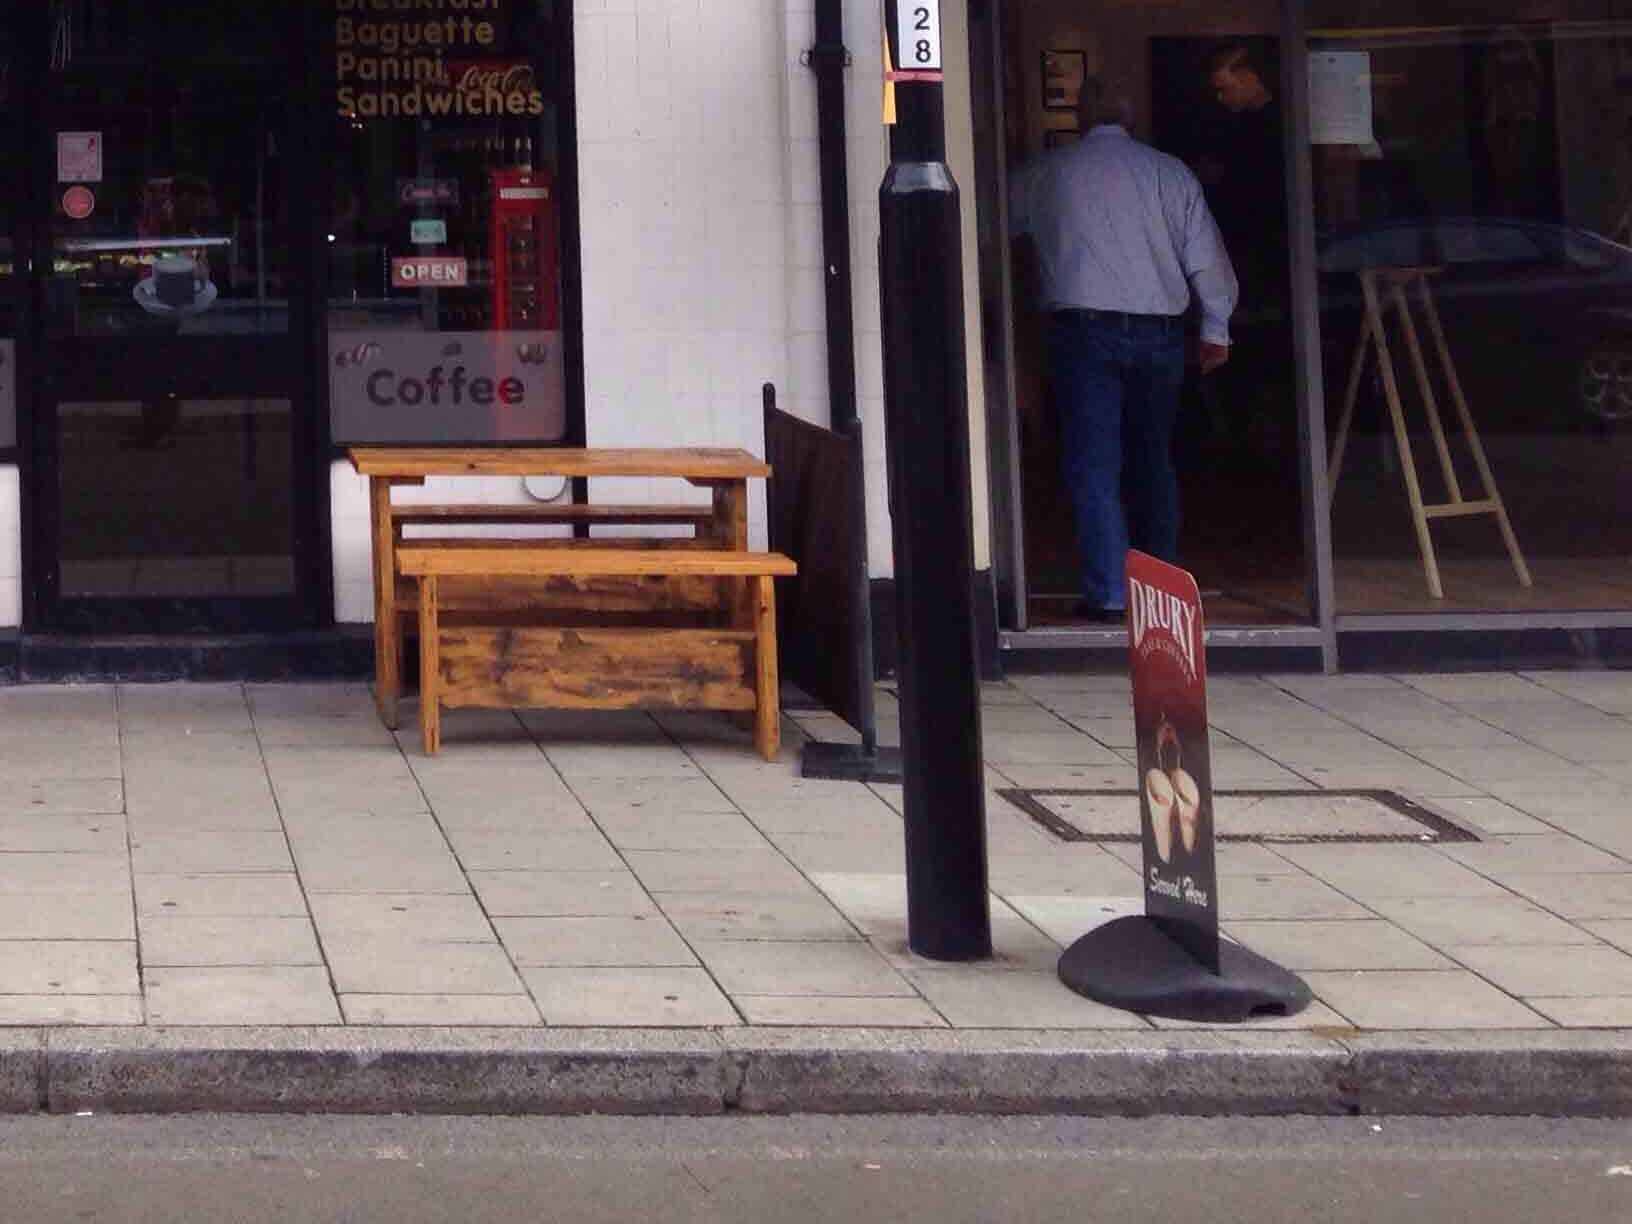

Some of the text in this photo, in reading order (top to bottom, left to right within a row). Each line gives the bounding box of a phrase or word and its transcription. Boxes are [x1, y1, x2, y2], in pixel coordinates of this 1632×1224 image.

[336, 16, 495, 52] Baguette
[337, 48, 443, 81] Panini
[337, 85, 545, 115] Sandwiches
[400, 264, 459, 279] OPEN
[367, 365, 525, 407] Coffee
[1129, 577, 1197, 681] DRURY
